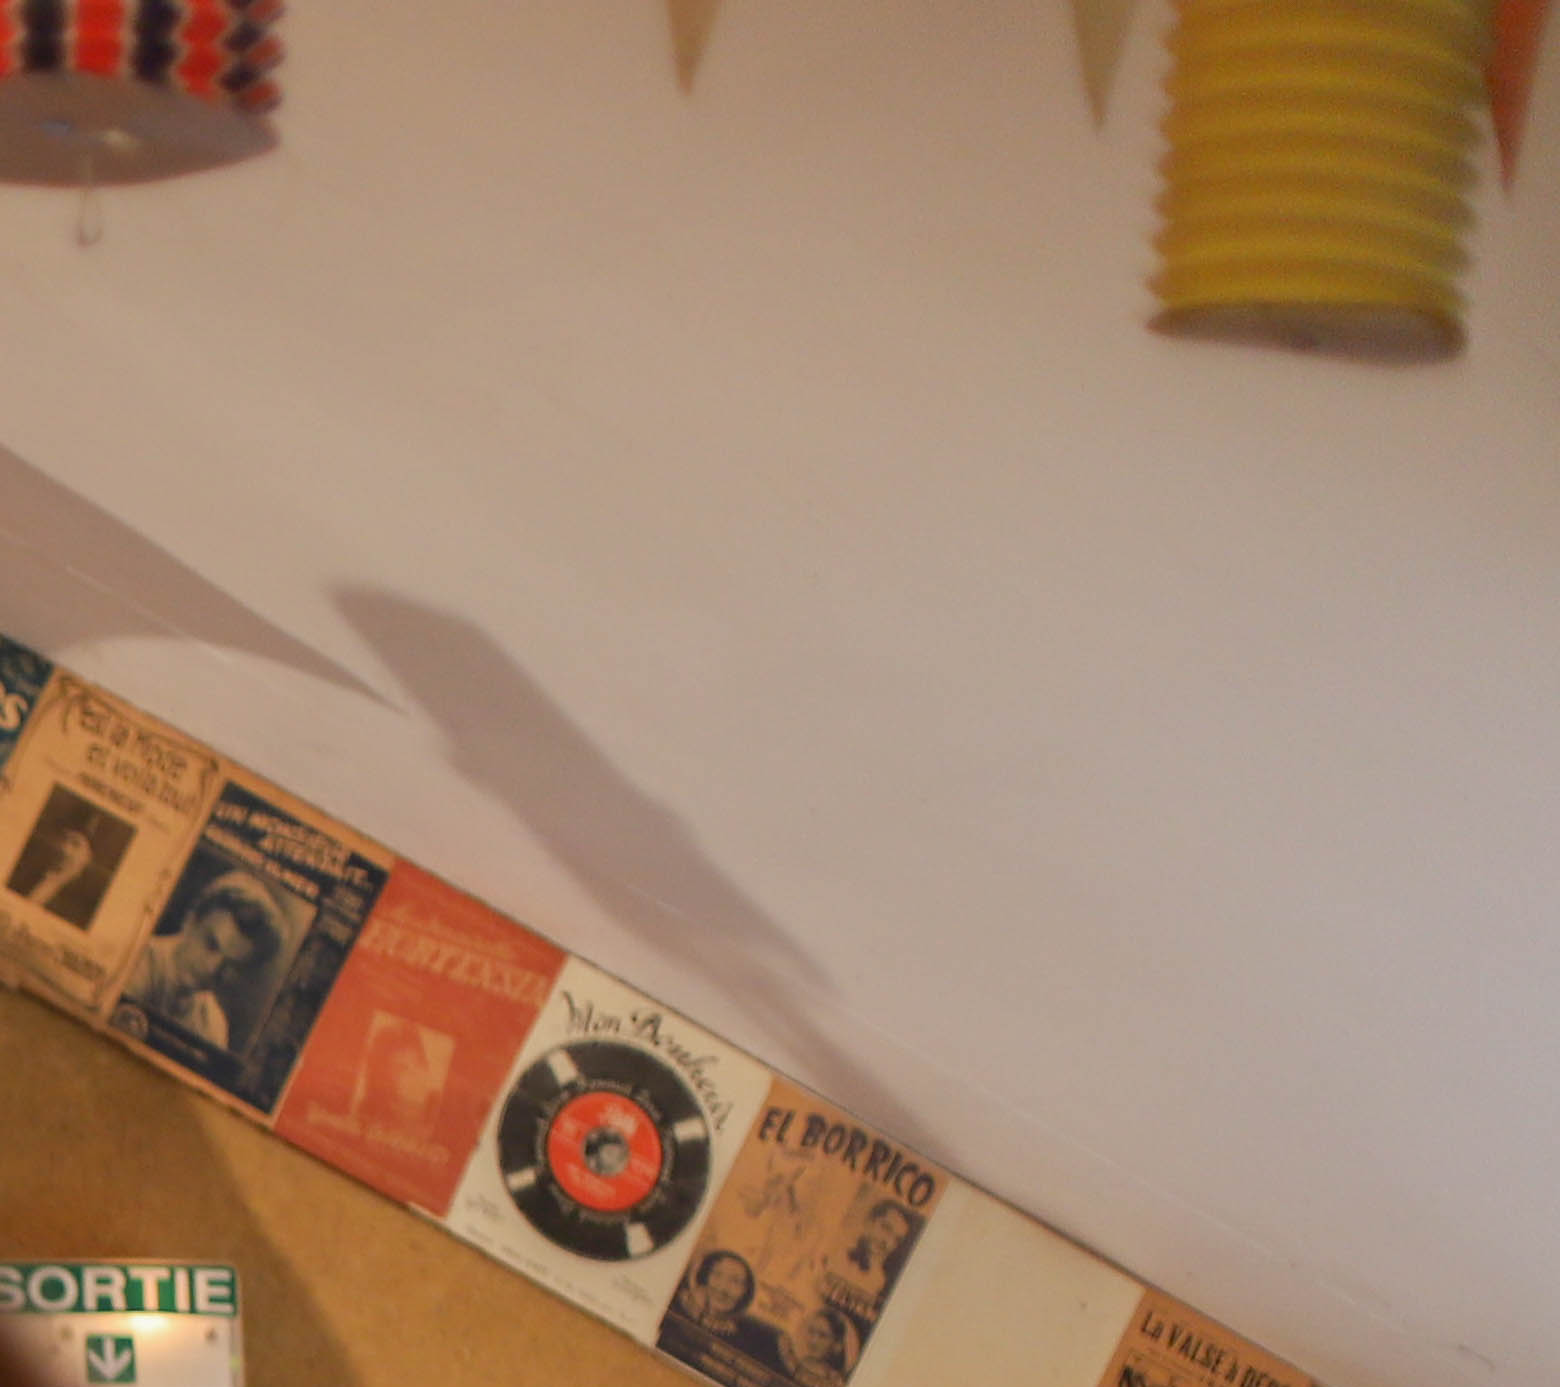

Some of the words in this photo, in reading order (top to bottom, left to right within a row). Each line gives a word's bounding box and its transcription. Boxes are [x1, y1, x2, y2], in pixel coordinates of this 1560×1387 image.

[757, 1104, 799, 1146] EL
[798, 1113, 939, 1208] BORRICO
[1162, 1322, 1228, 1375] VALSE
